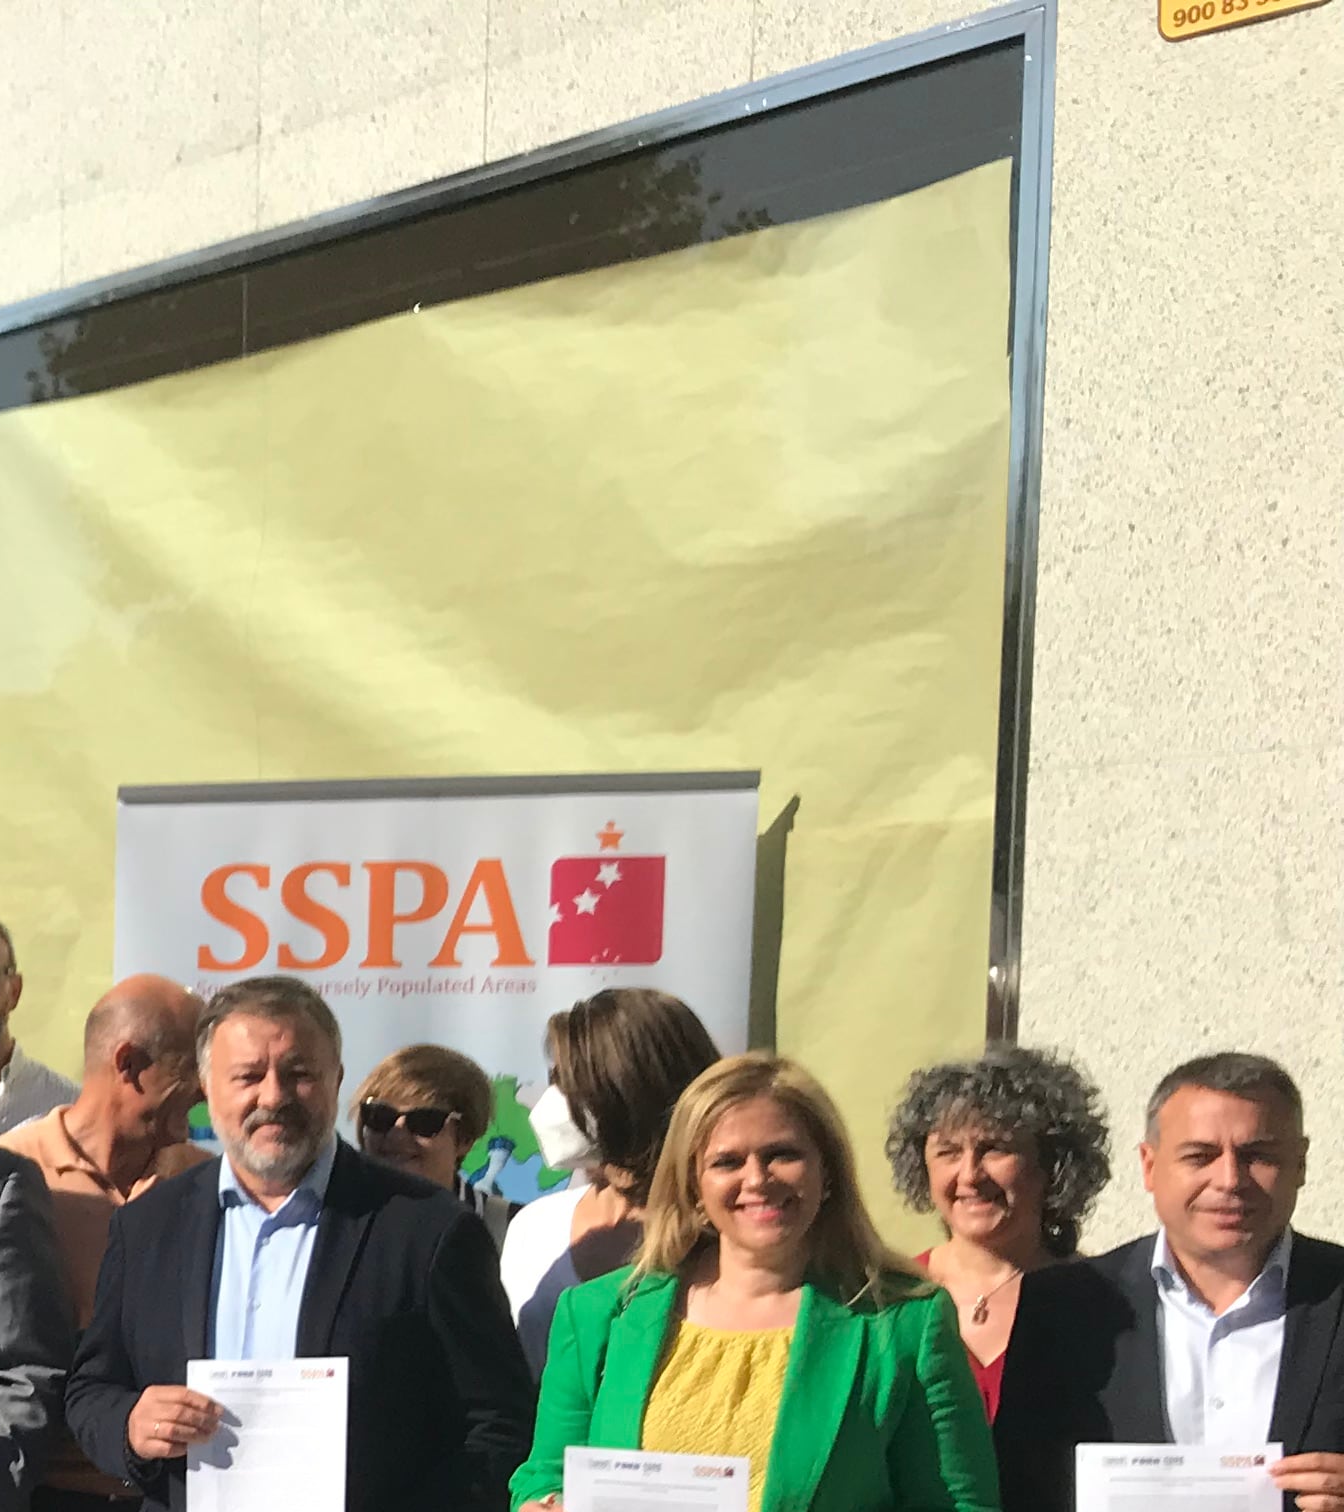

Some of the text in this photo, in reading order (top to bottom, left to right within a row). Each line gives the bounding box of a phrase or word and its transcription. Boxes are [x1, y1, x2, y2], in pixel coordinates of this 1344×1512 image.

[1173, 3, 1215, 28] 900
[197, 858, 536, 972] SSPA
[377, 974, 474, 998] Populated
[480, 974, 538, 995] Areas
